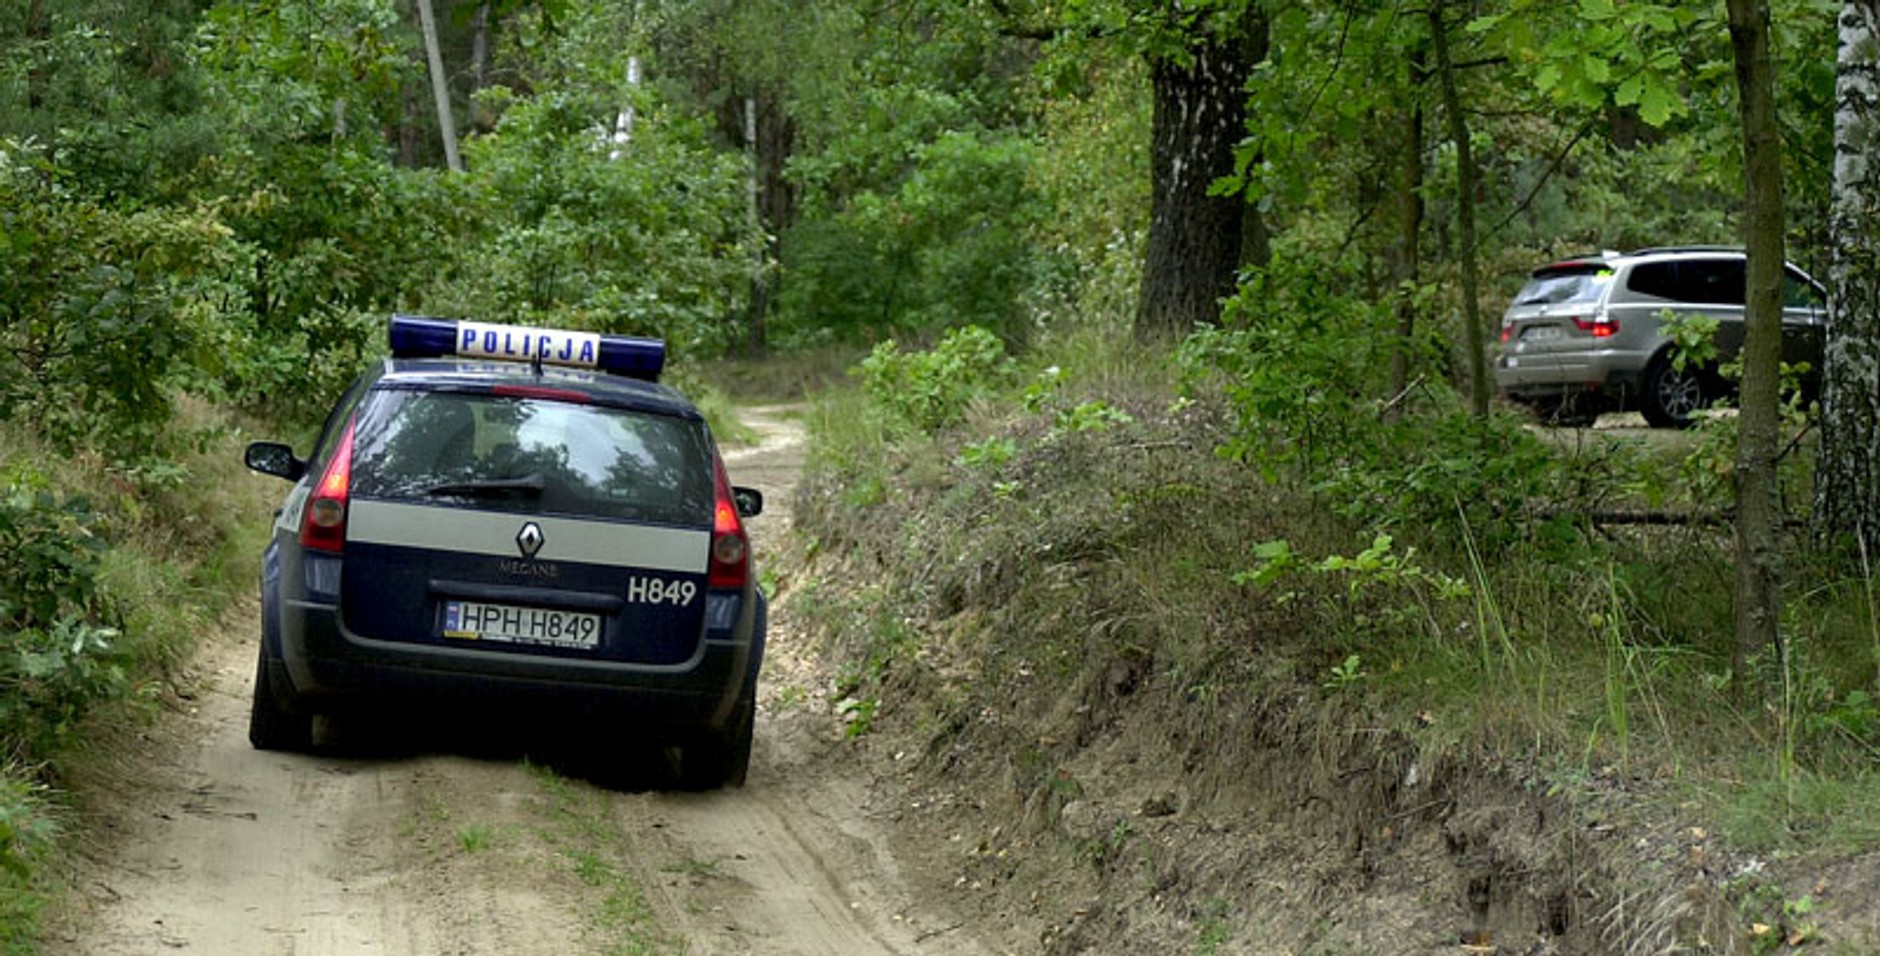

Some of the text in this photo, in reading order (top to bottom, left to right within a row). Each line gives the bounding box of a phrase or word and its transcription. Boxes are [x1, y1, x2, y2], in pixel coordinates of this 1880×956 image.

[462, 328, 594, 362] POLICJA
[499, 560, 559, 576] MEGANE
[628, 576, 697, 607] H849
[463, 604, 595, 642] HPH H849
